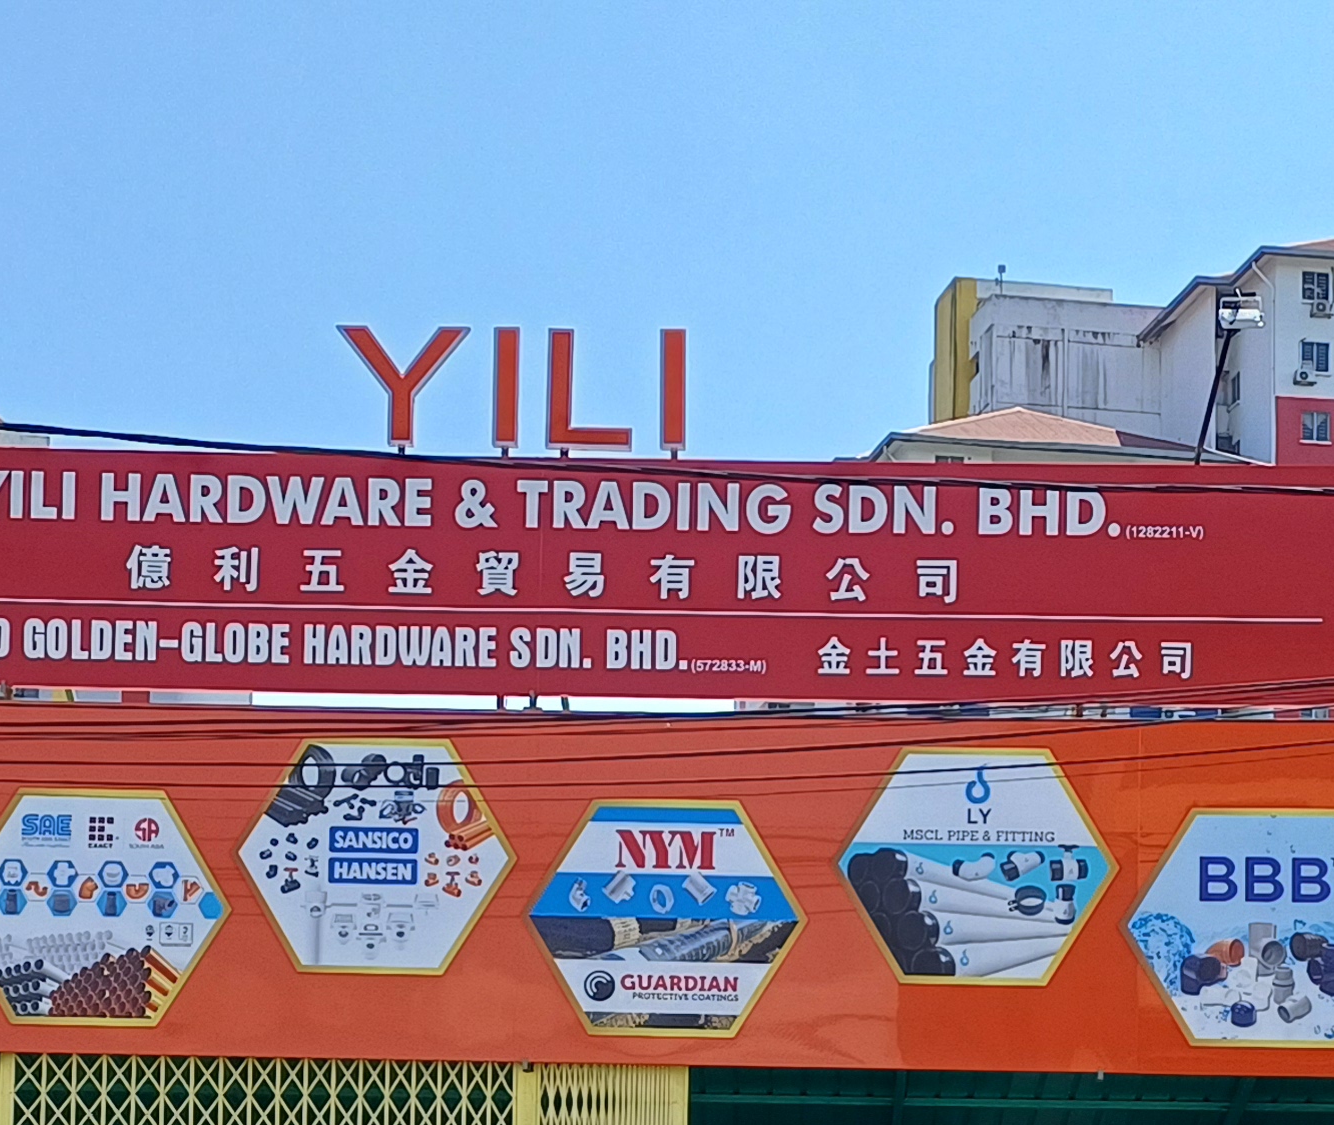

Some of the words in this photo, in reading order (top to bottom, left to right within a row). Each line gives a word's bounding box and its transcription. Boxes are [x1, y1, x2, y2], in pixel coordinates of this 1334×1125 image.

[335, 324, 687, 450] YILI
[100, 471, 433, 528] HARDWARE
[454, 479, 499, 529] &
[517, 479, 792, 534] TRADING
[812, 482, 955, 535] SDN.
[977, 488, 1122, 538] BHD.
[127, 544, 959, 605] 億利五金貿易有限公司
[23, 618, 289, 665] GOLDEN-GLOBE
[304, 623, 497, 668] HARDWARE
[509, 628, 591, 669] SDN.
[606, 629, 688, 672] BHD.
[691, 655, 767, 676] (572833-M)
[818, 636, 1194, 679] 金土五金有限公司
[21, 813, 72, 836] SAE
[967, 808, 992, 824] LY
[334, 830, 413, 849] SANSICO
[615, 828, 717, 871] NYM
[903, 829, 943, 841] MSCL
[947, 830, 979, 841] PIPE
[983, 831, 992, 841] &
[996, 830, 1055, 842] FITTING
[333, 861, 413, 881] HANSEN
[1199, 856, 1332, 903] BBB
[620, 974, 739, 992] GUARDIAN
[632, 991, 689, 1001] PROTECTIVE
[692, 993, 739, 1002] COATINGS
